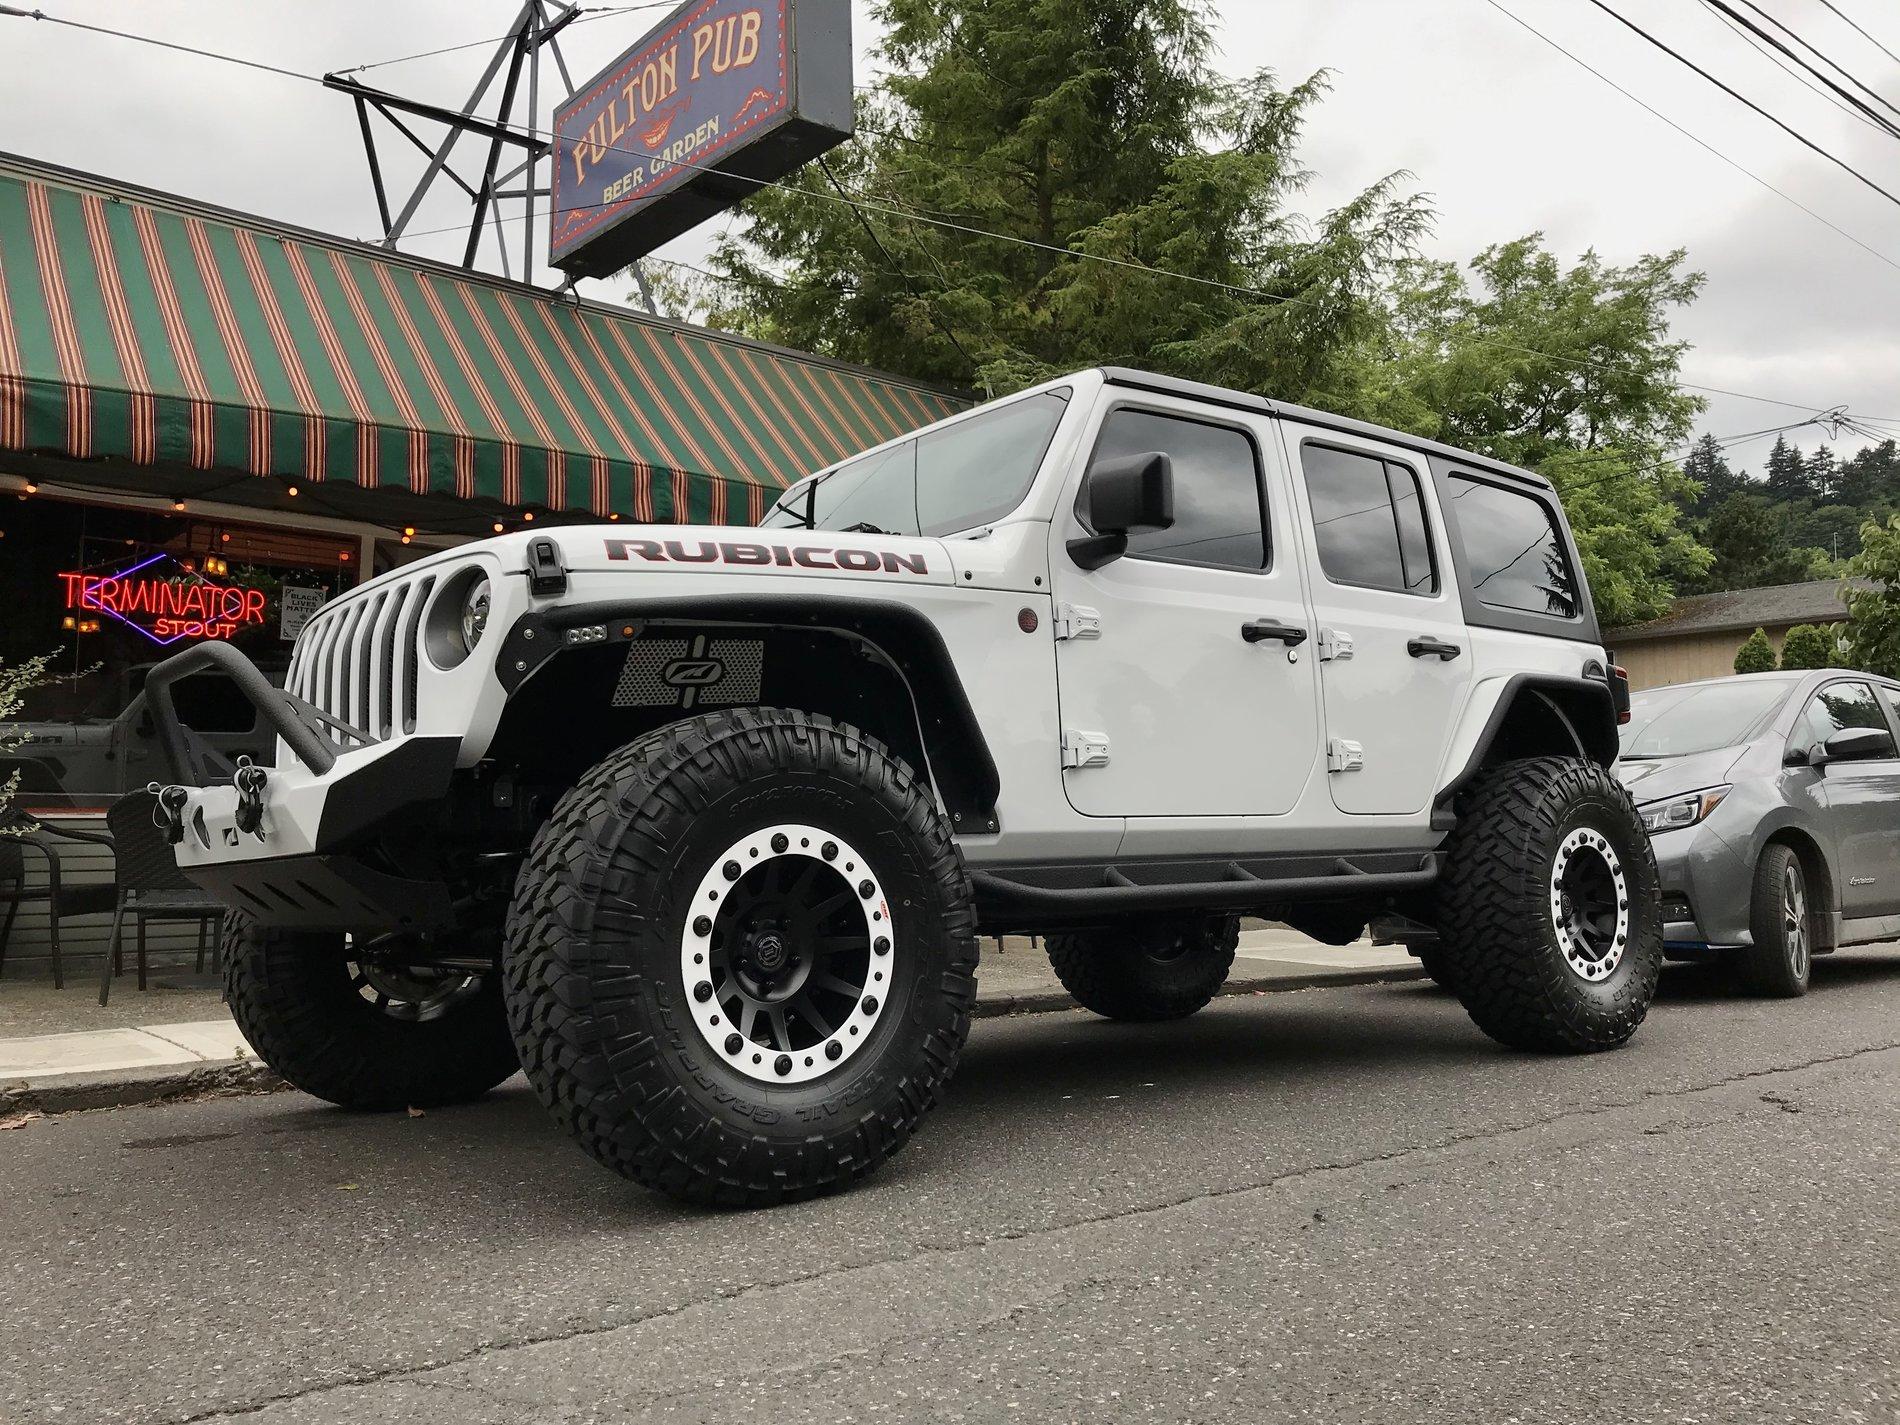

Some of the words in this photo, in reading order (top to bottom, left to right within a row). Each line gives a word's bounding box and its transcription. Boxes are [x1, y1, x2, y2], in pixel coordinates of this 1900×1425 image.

[573, 45, 679, 186] FULTON
[691, 11, 761, 80] PUB
[603, 167, 643, 205] BEER
[650, 115, 720, 175] GARDEN
[603, 539, 928, 575] RUBICON
[59, 573, 265, 623] TERMINATOR
[291, 594, 318, 602] BLACK
[155, 619, 236, 639] STOUT
